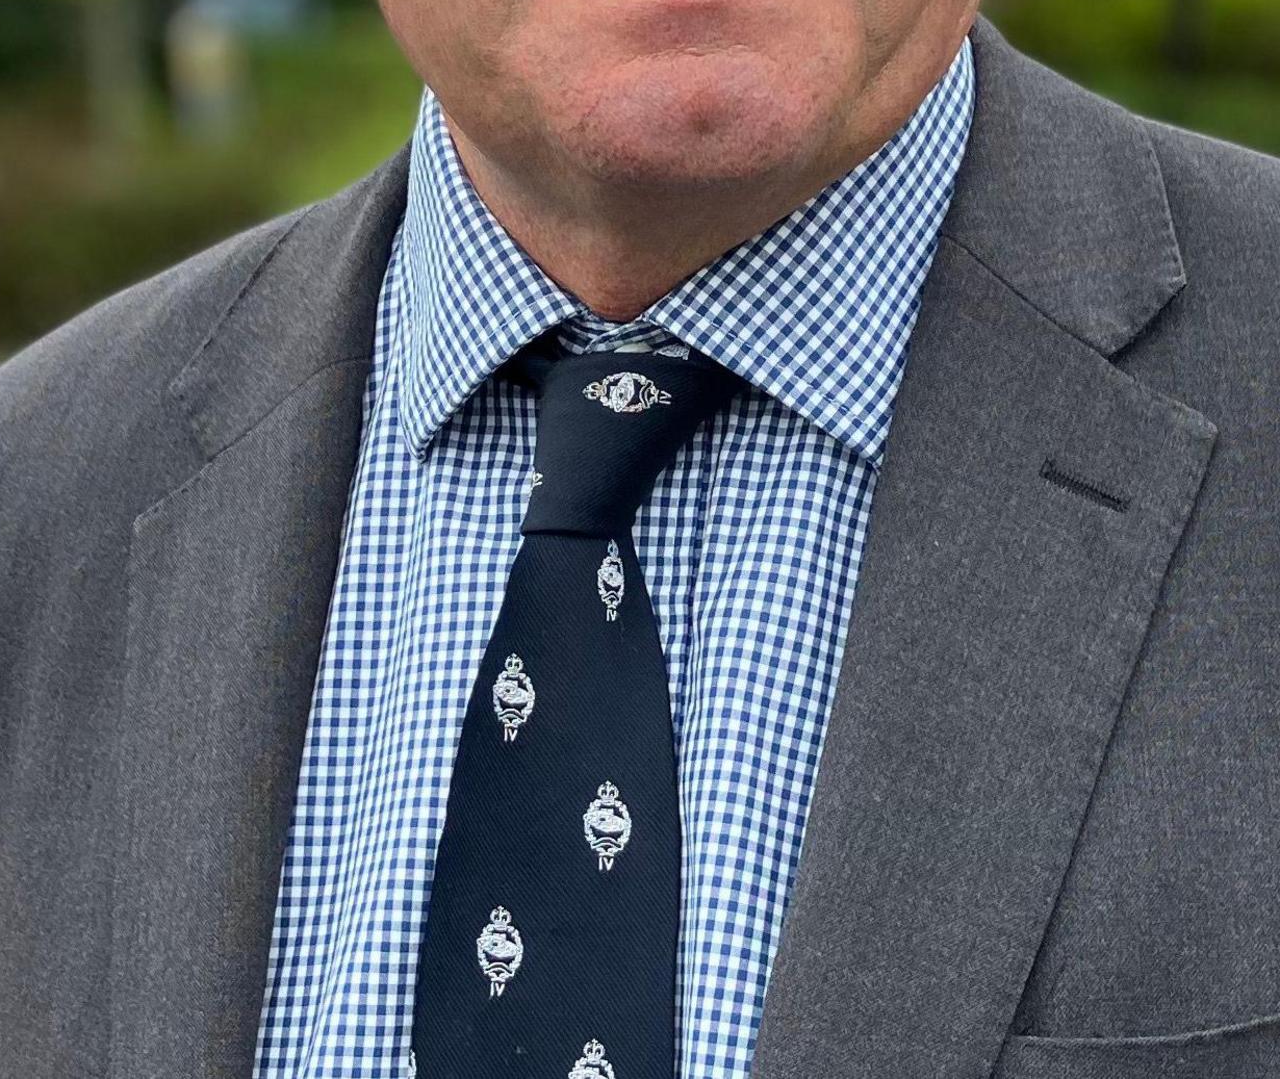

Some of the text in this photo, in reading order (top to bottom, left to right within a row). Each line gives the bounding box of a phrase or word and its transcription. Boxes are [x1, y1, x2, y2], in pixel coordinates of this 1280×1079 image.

[659, 391, 672, 405] IV
[606, 609, 617, 621] IV
[504, 728, 518, 742] IV
[598, 857, 614, 871] IV
[490, 982, 505, 997] IV
